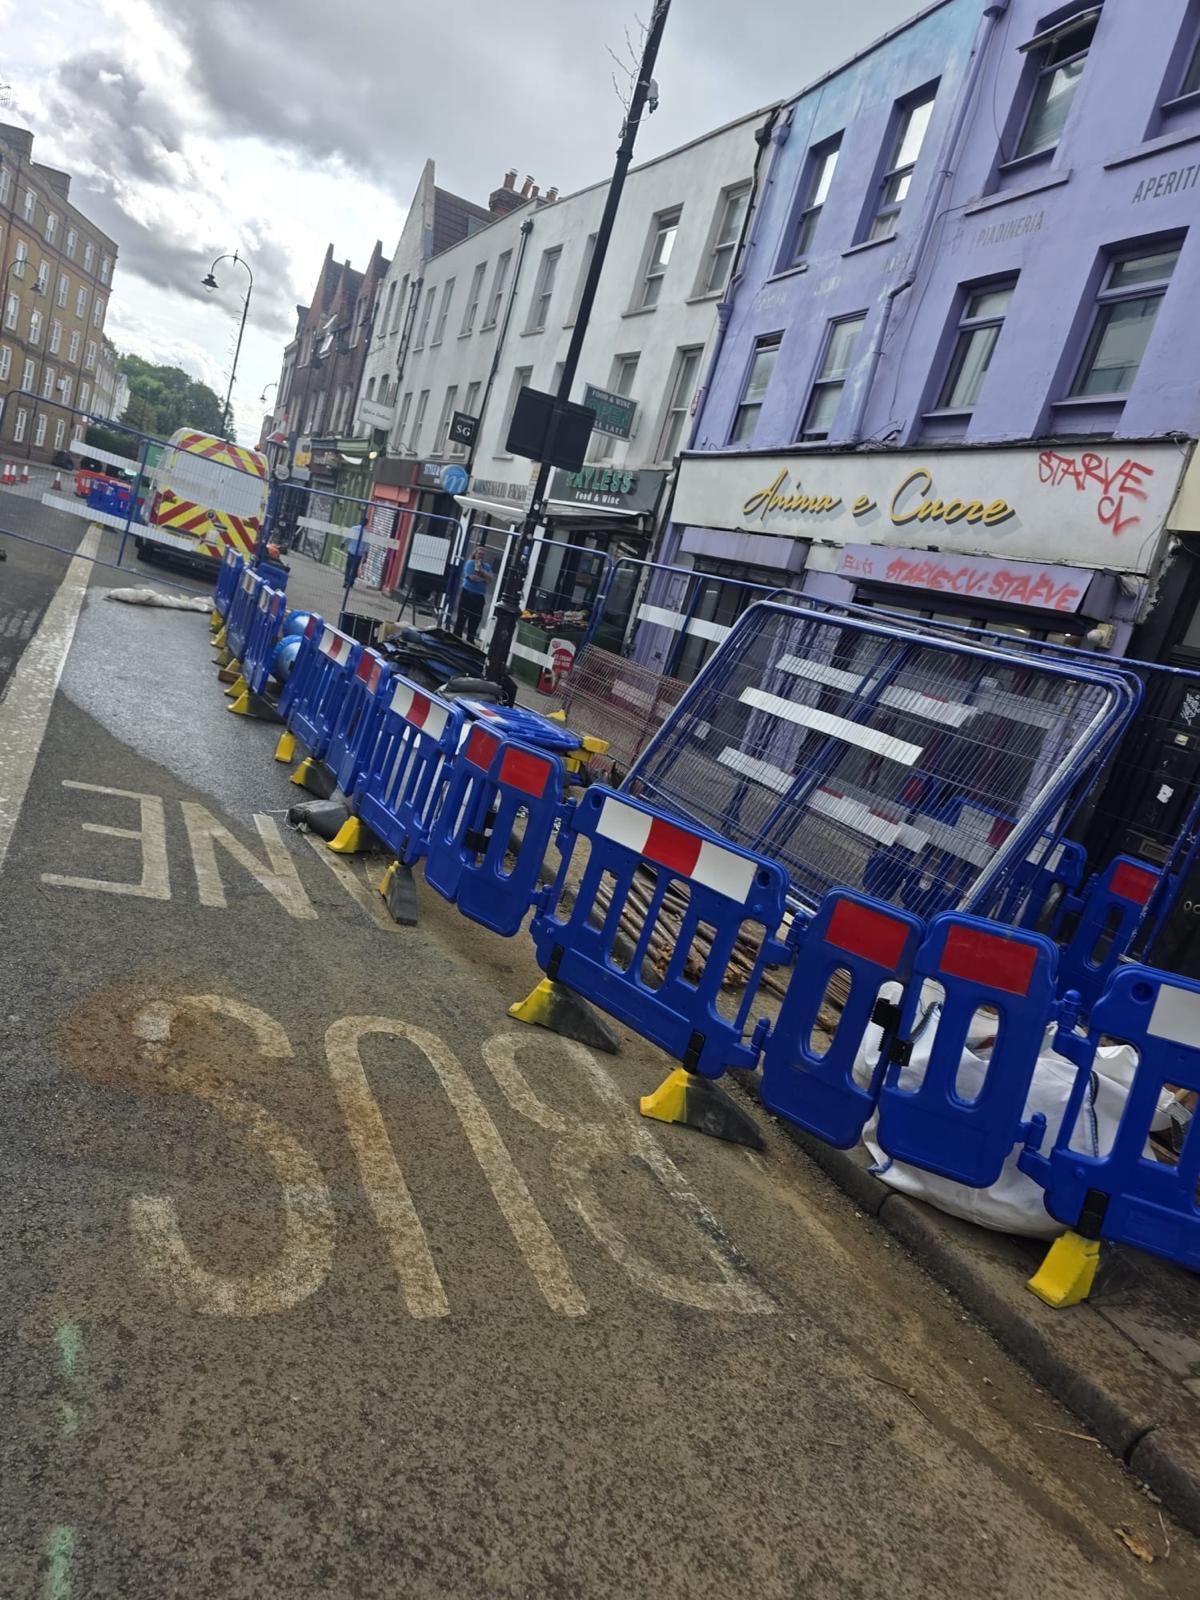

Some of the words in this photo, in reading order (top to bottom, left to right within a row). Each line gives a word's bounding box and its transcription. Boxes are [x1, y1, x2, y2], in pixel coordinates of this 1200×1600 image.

[456, 424, 471, 437] SG
[743, 465, 841, 521] Anima
[852, 494, 877, 518] e
[890, 466, 1016, 528] Cuore
[1038, 451, 1154, 501] STARVE
[128, 993, 782, 1320] BUS
